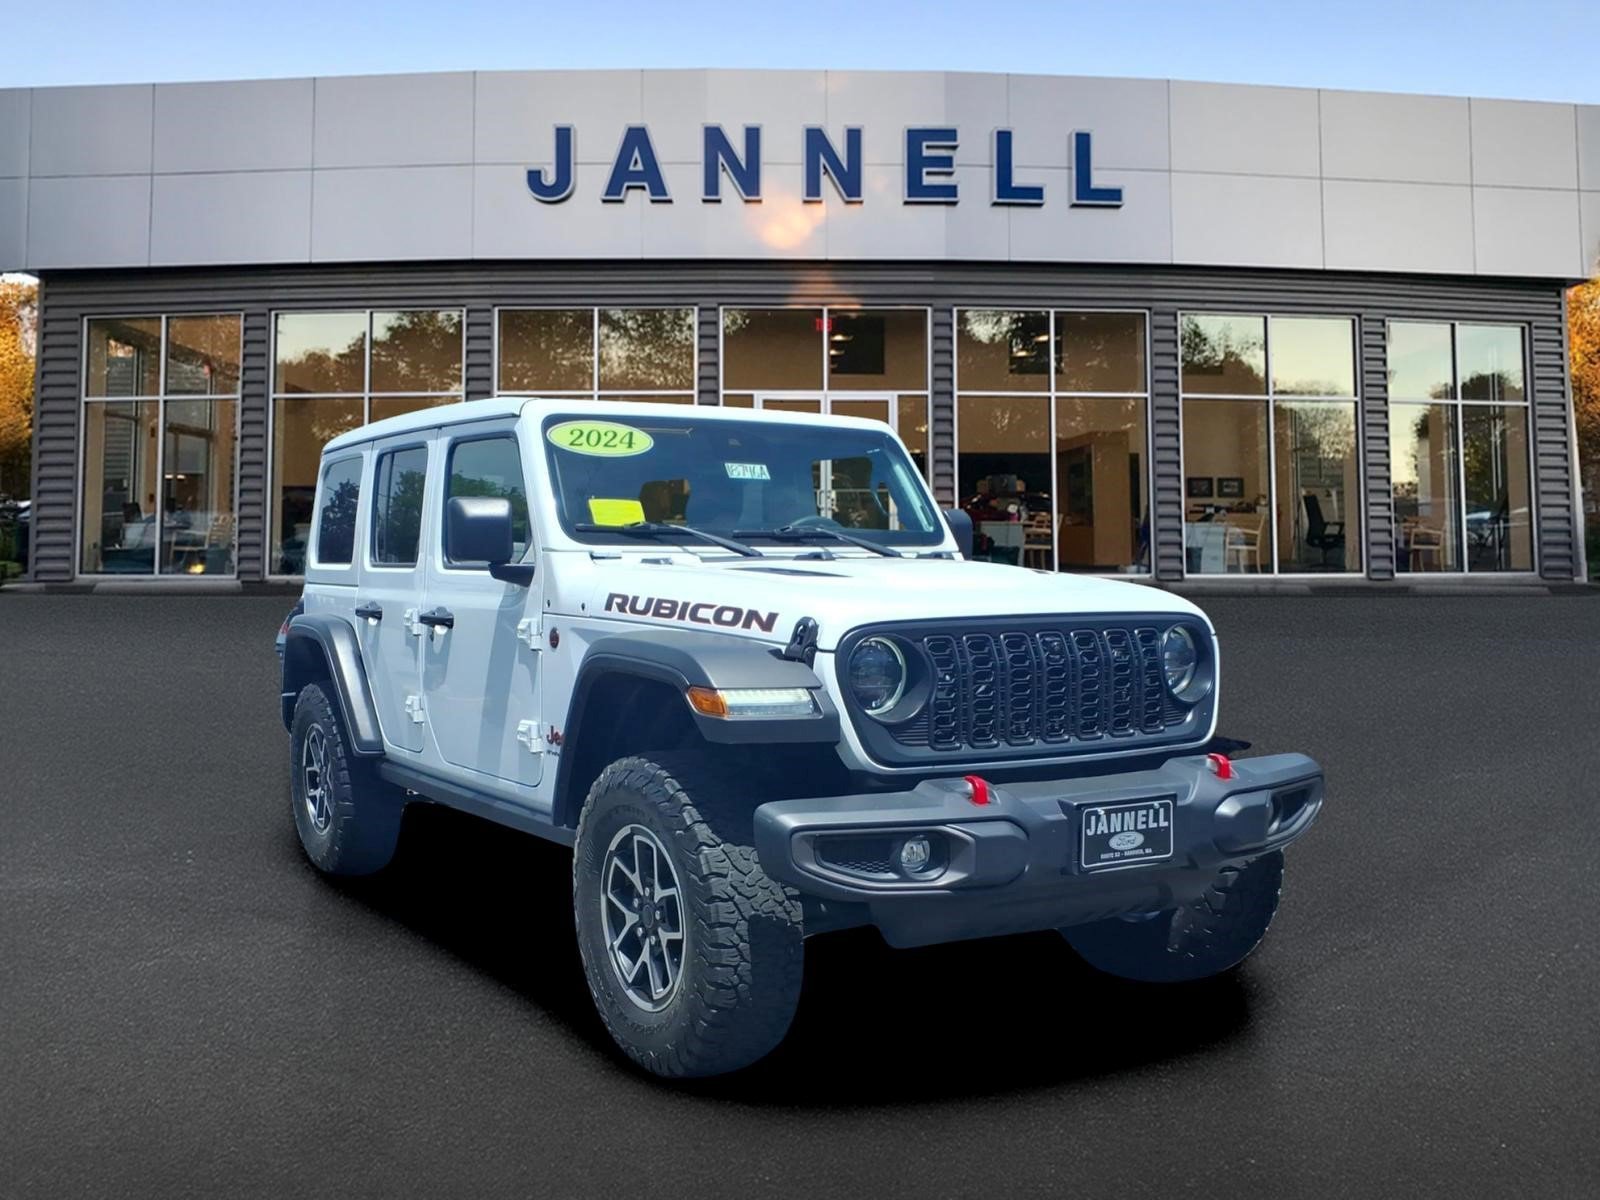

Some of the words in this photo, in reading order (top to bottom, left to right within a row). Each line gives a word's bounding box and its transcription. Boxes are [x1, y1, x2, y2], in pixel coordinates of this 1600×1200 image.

[525, 123, 1123, 207] JANNELL
[568, 428, 637, 449] 2024
[603, 592, 780, 633] RUBICON
[546, 725, 565, 747] Je
[1086, 807, 1169, 836] JANNELL
